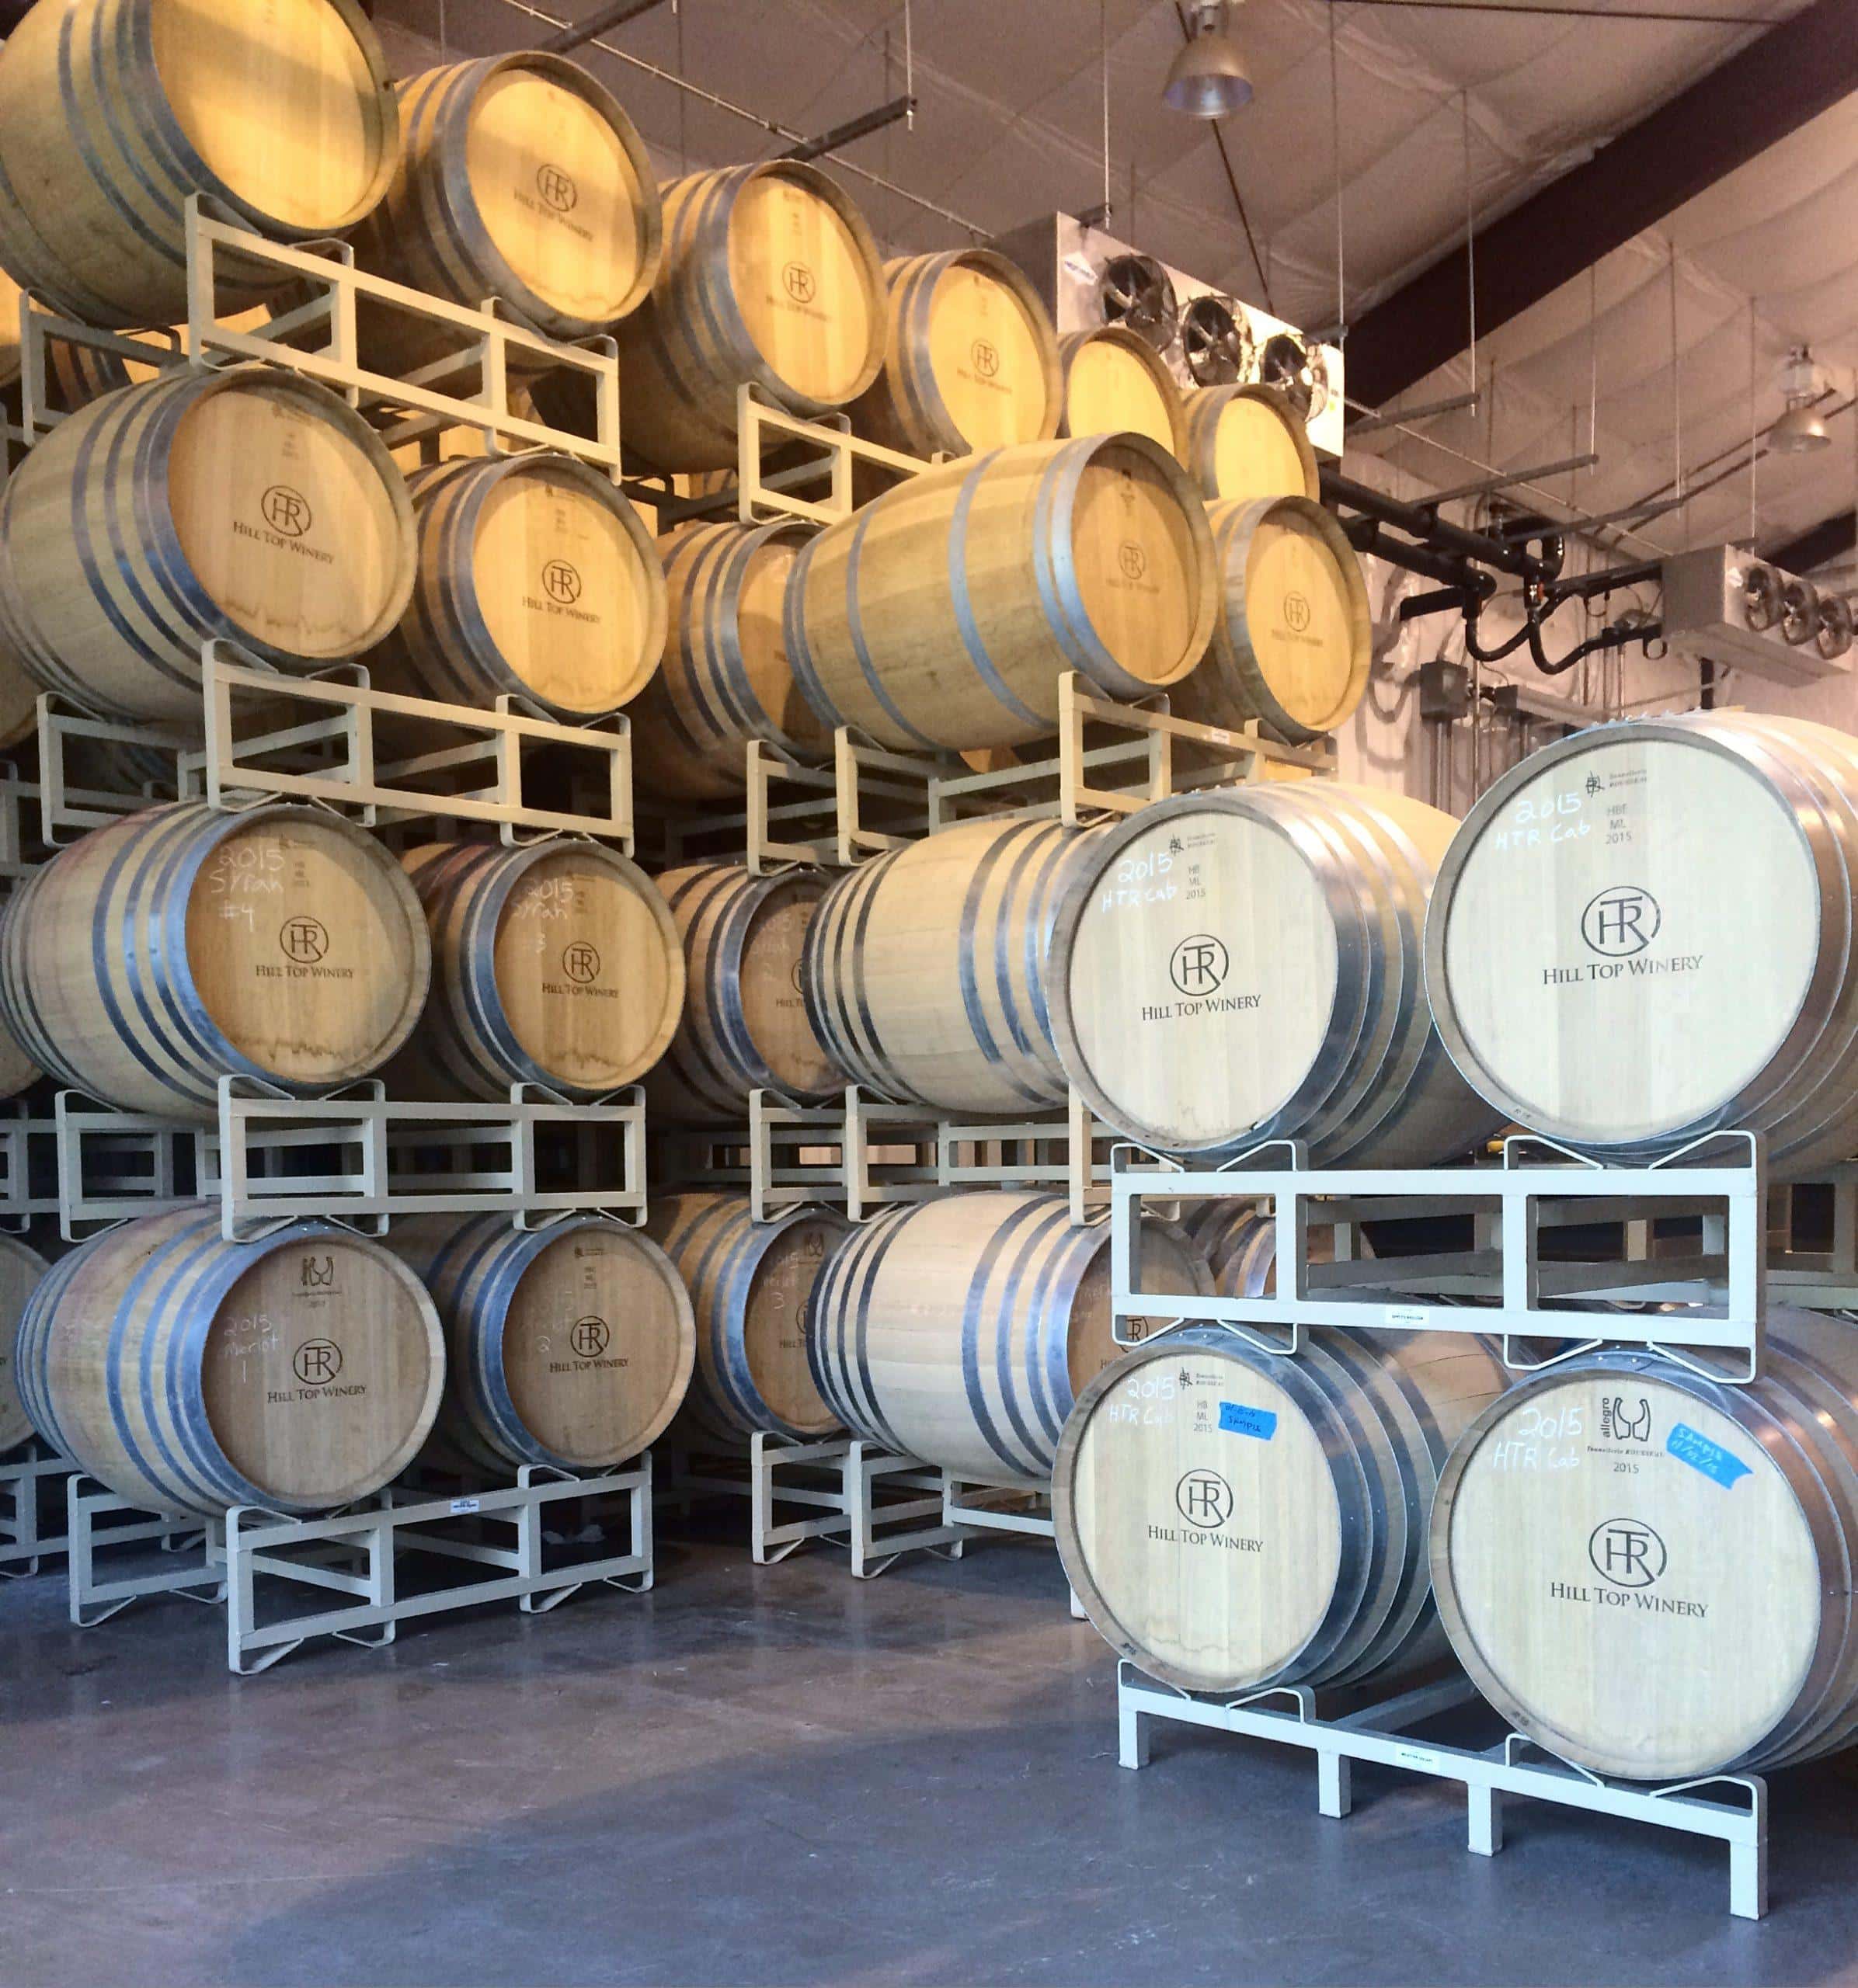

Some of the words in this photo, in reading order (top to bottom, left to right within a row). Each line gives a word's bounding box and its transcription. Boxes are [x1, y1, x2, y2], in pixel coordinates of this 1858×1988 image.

[1515, 792, 1582, 825] 2015
[1495, 828, 1542, 851] HTR
[1606, 831, 1632, 845] 2015
[219, 845, 286, 871] 2015
[1119, 851, 1173, 884] 2015
[1101, 888, 1140, 914] HTR
[256, 964, 284, 978] HILL
[285, 965, 308, 978] TOP
[311, 966, 353, 978] WINERY
[1543, 968, 1584, 985] HILL
[1587, 962, 1624, 981] TOP
[1628, 954, 1703, 977] WINERY
[1142, 1006, 1173, 1021] HILL
[1174, 1001, 1202, 1017] TOP
[1206, 994, 1261, 1012] WINERY
[267, 1390, 295, 1404] HILL
[297, 1388, 320, 1401] TOP
[323, 1385, 367, 1398] WINERY
[1126, 1375, 1176, 1400] 2015
[1108, 1403, 1138, 1426] HTR
[1519, 1407, 1584, 1437] 2015
[1600, 1397, 1612, 1438] allegro
[1493, 1441, 1537, 1473] HTR
[1613, 1461, 1640, 1474] 2015
[1148, 1524, 1178, 1543] HILL
[1180, 1529, 1207, 1546] TOP
[1209, 1531, 1264, 1553] WINERY
[1550, 1581, 1592, 1602] HILL
[1595, 1587, 1630, 1607] TOP
[1634, 1593, 1709, 1618] WINERY
